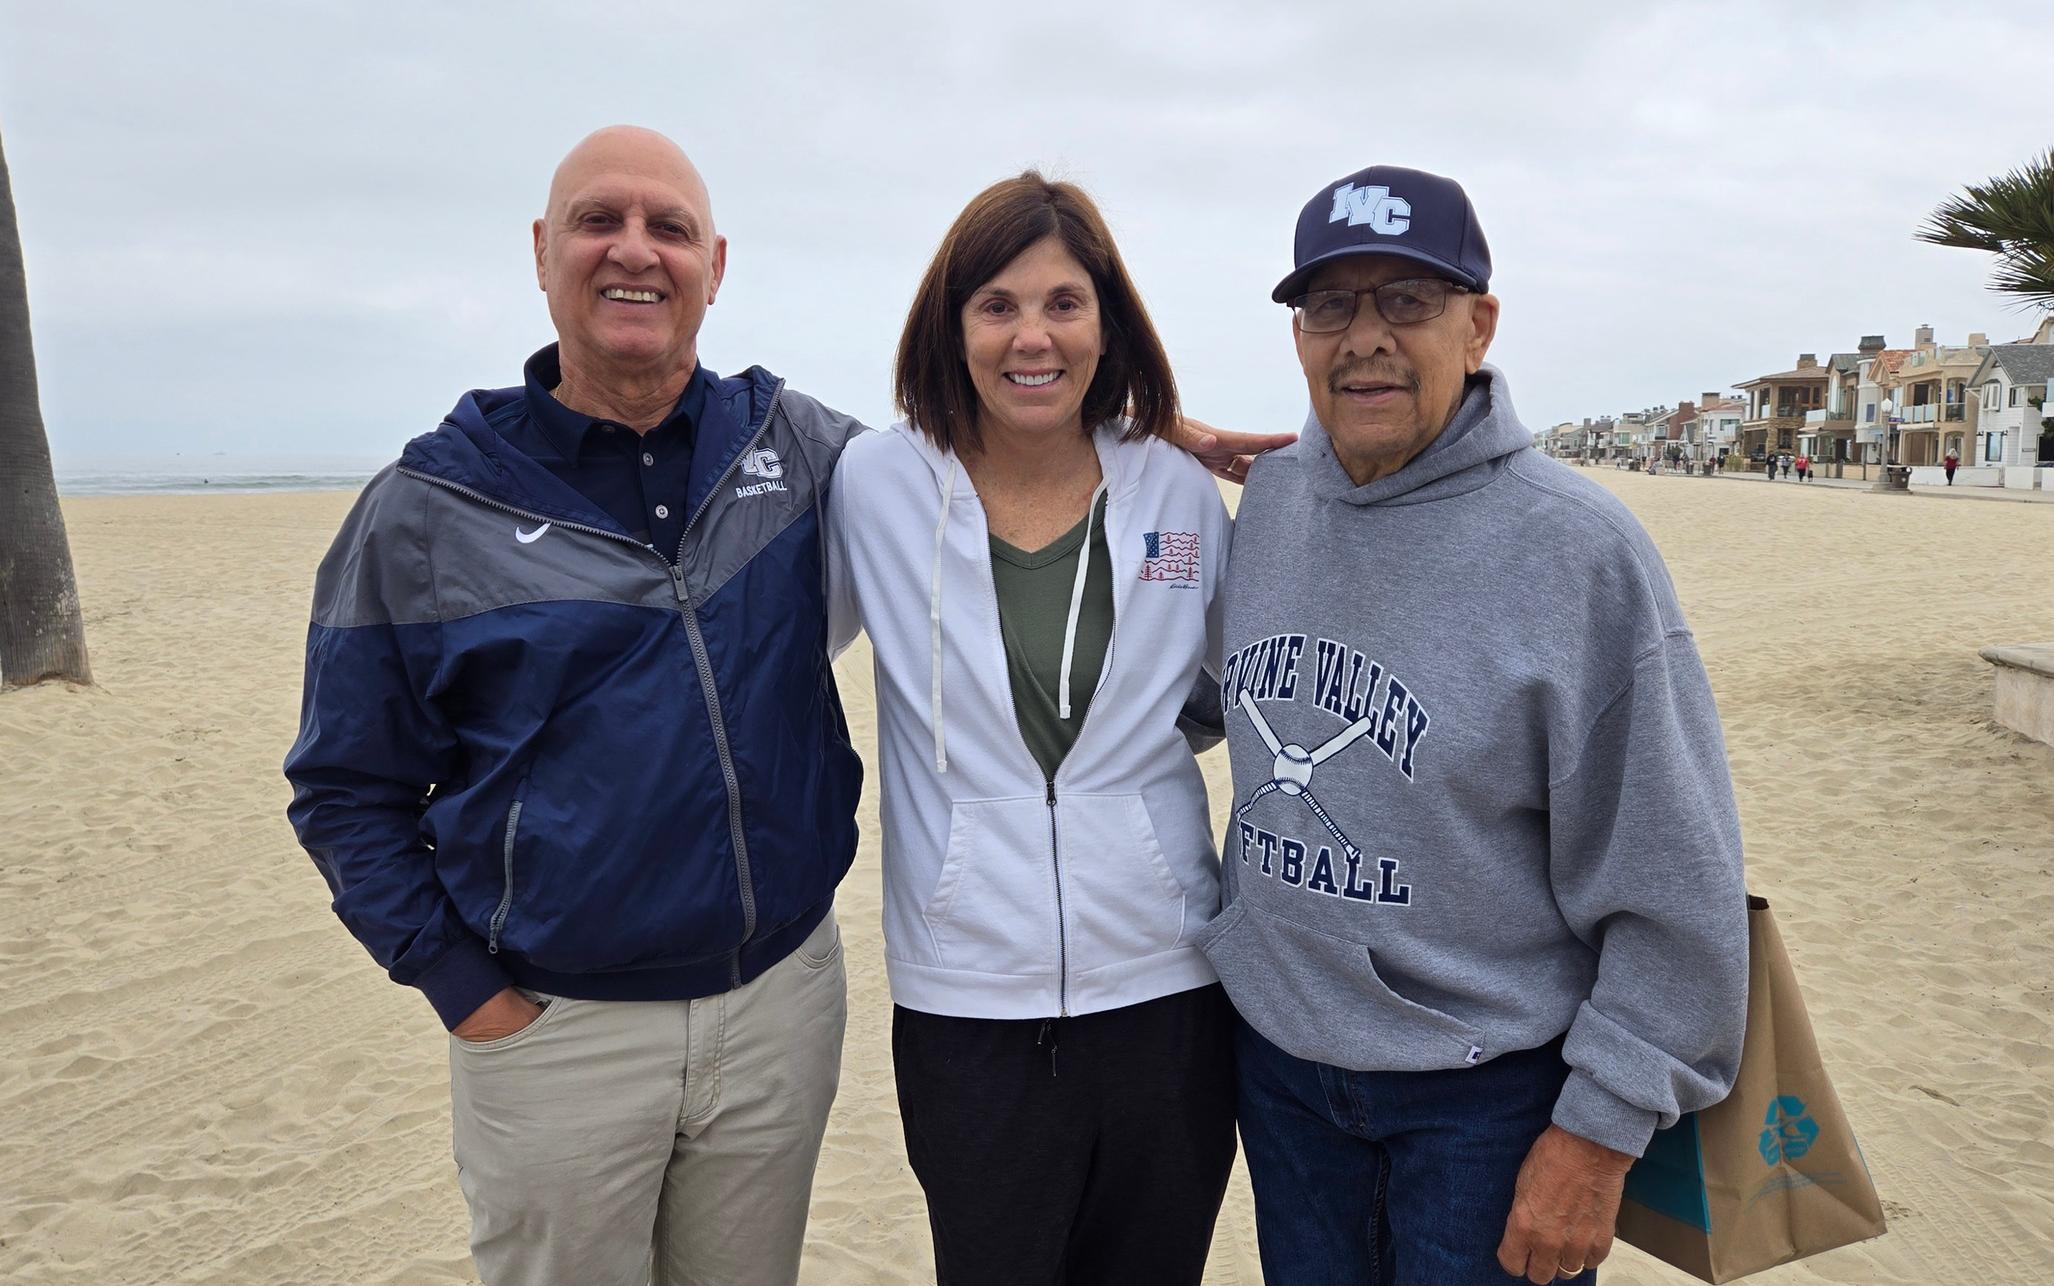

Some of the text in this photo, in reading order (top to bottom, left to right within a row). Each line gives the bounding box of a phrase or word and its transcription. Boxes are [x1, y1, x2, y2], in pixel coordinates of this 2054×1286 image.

[1328, 182, 1411, 236] IVC
[735, 480, 788, 498] BASKETBALL
[1221, 633, 1430, 783] RVINE VALLEY
[1237, 819, 1411, 906] FTBALL
